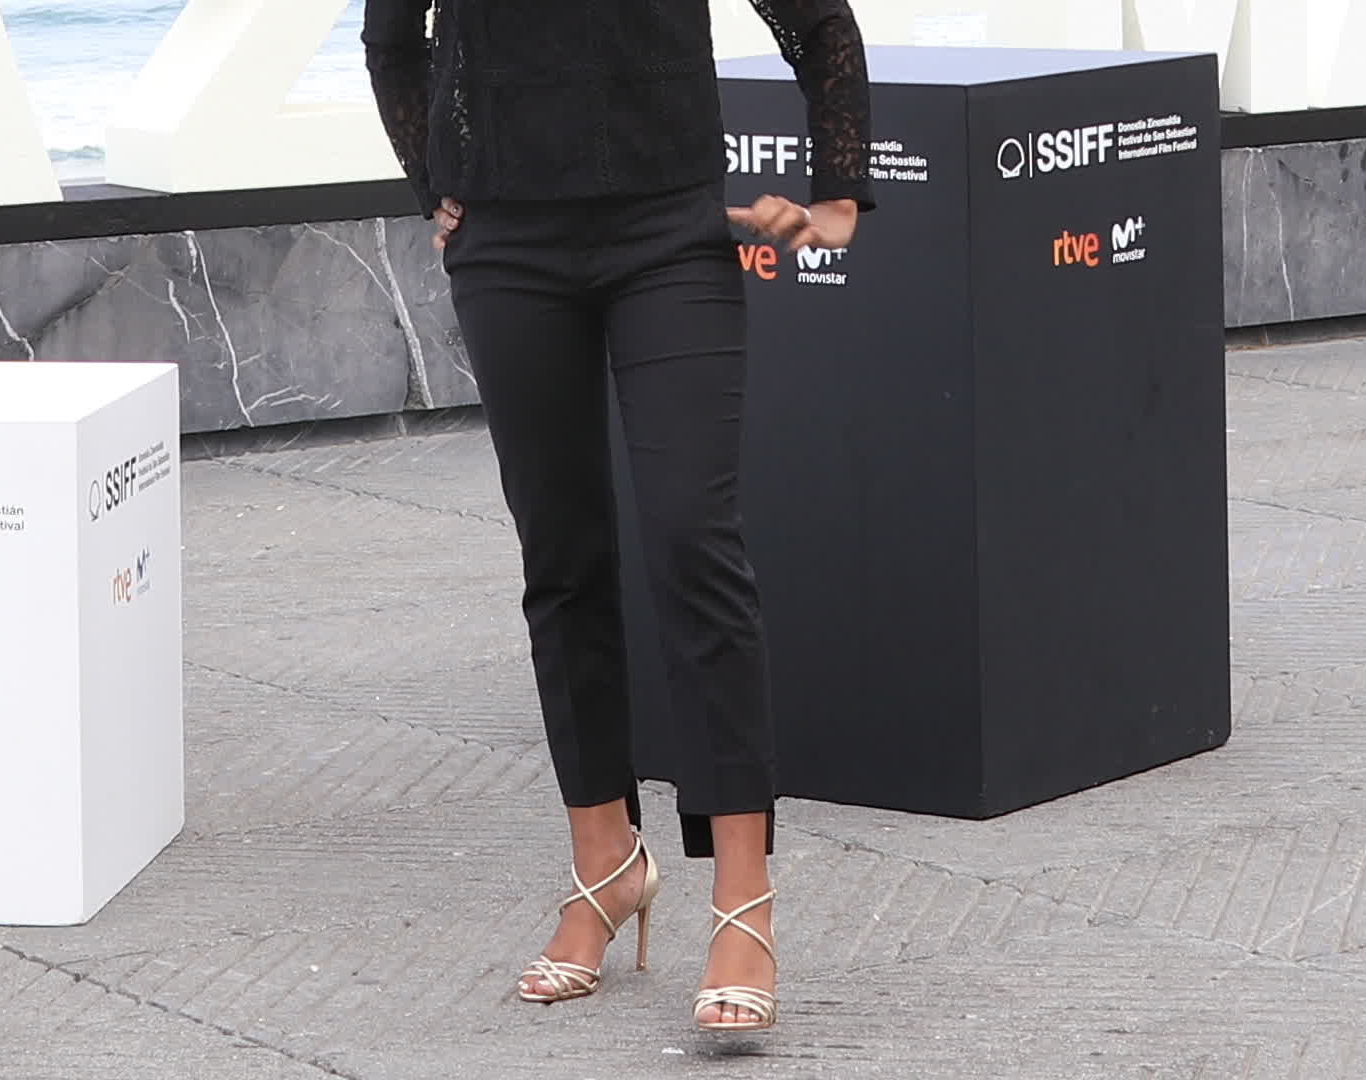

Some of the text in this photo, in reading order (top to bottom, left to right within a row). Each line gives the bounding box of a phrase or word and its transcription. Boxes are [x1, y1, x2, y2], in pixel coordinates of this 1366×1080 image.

[1037, 124, 1113, 172] SSIFF
[1118, 133, 1143, 147] Festival
[1152, 130, 1165, 142] San
[1118, 138, 1197, 161] International Film Festival
[723, 133, 799, 174] SIFF
[890, 168, 928, 181] Festival
[1053, 230, 1100, 267] rtve
[1112, 248, 1146, 264] movistar
[797, 272, 847, 285] movistar
[106, 455, 137, 512] SSIFF
